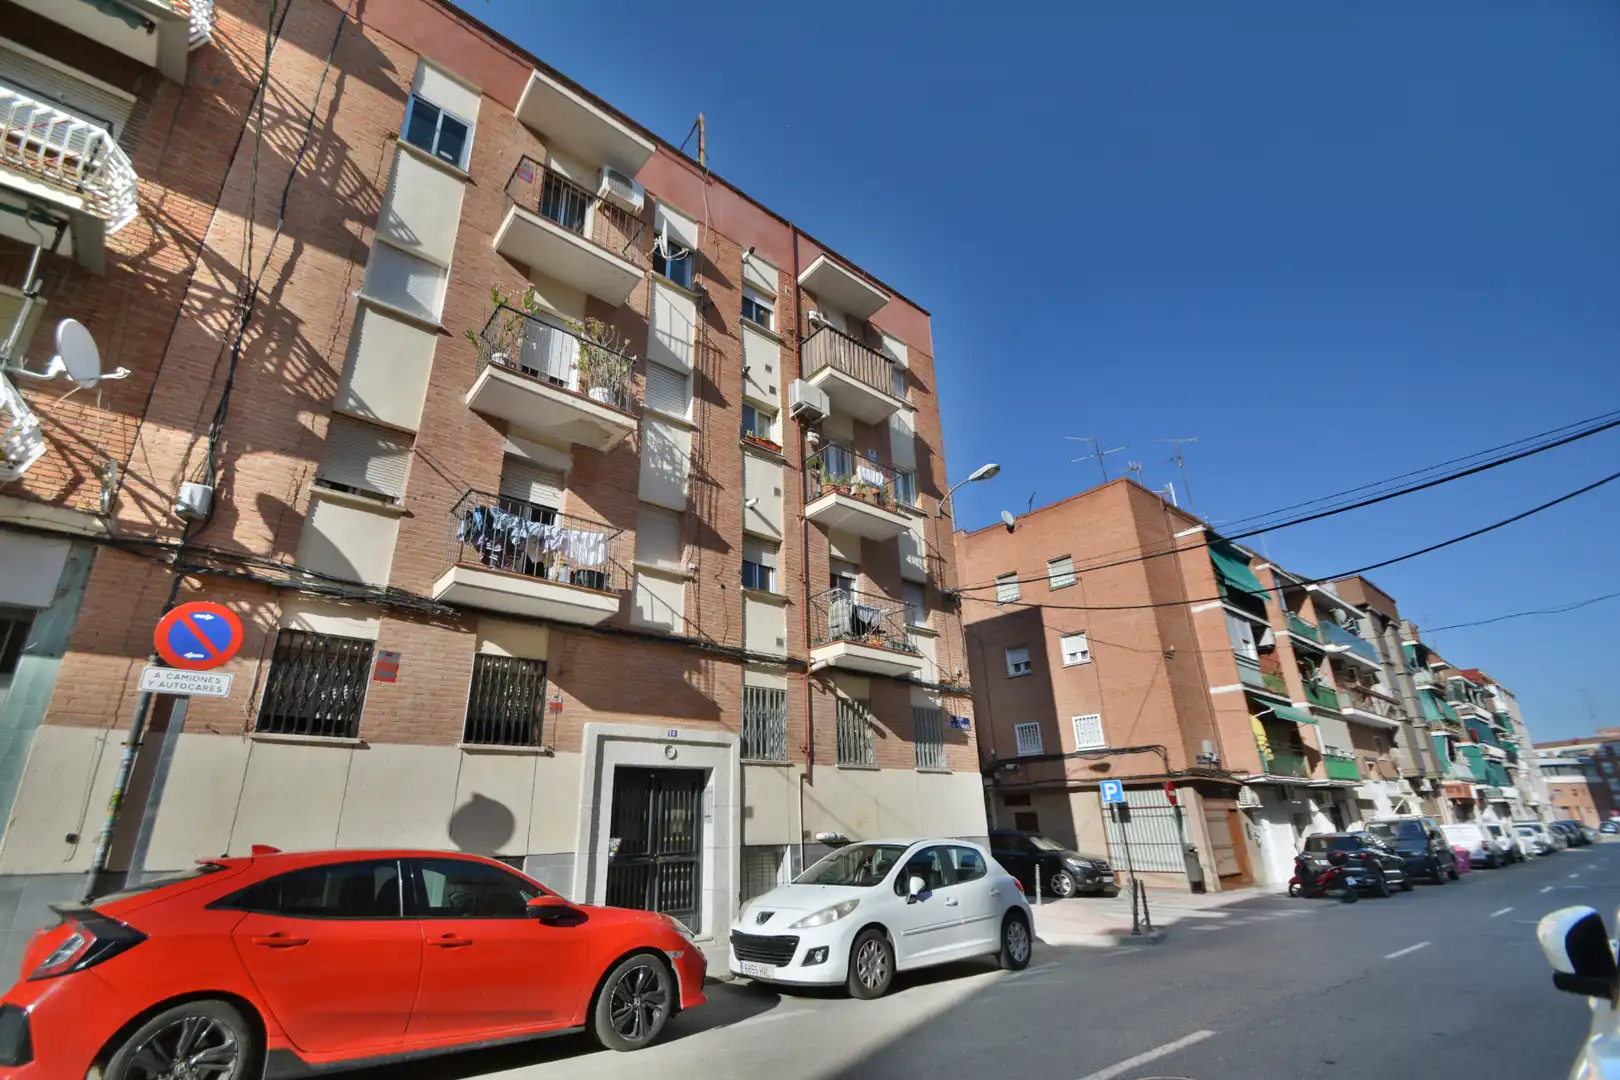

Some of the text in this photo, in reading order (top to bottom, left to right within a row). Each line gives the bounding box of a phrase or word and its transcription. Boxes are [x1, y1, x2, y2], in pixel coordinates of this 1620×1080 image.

[166, 672, 221, 684] CAMIONES
[159, 681, 223, 692] AUTOCARES
[1104, 783, 1118, 800] P
